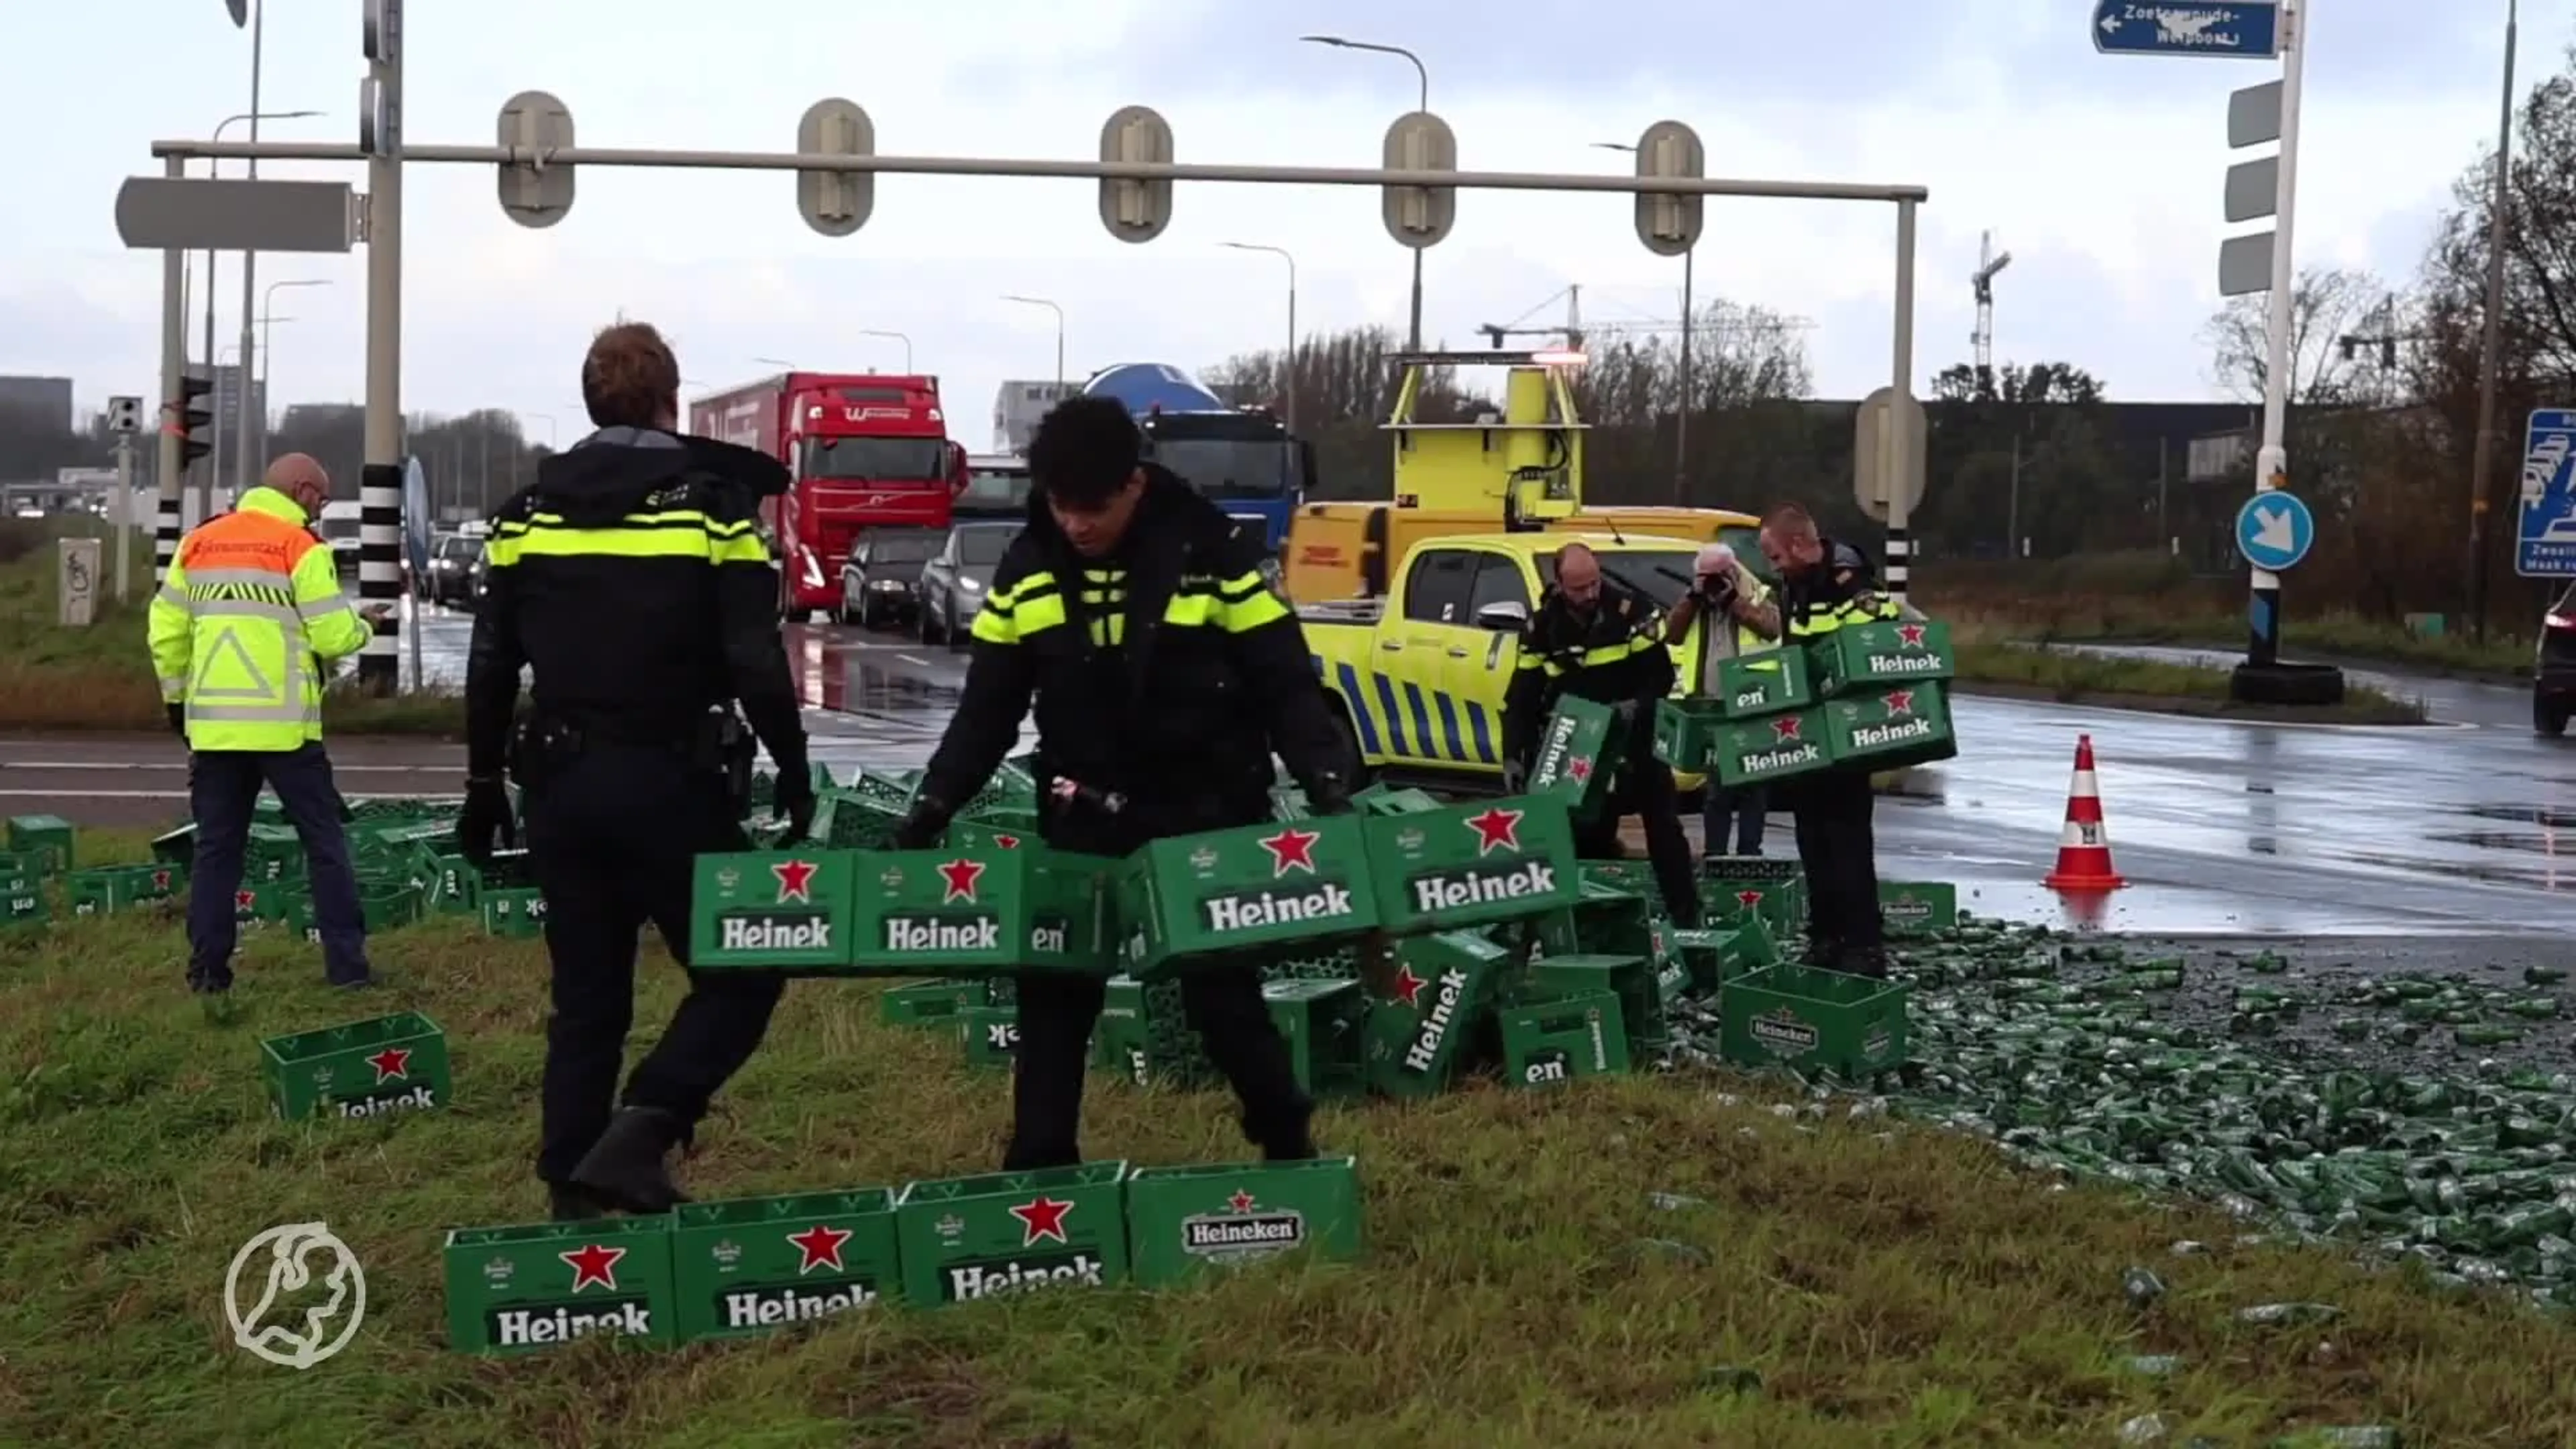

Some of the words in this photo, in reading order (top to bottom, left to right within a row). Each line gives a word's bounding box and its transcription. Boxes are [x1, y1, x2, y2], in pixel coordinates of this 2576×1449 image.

[1869, 653, 1943, 673] Heinek
[1852, 717, 1931, 747] Heinek
[1538, 716, 1576, 788] Heinek
[1743, 743, 1819, 773] Heinek
[1414, 861, 1556, 912] Heinek
[1205, 883, 1352, 931] Heinek
[721, 916, 831, 949] Heinek
[886, 916, 999, 951] Heinek
[1406, 966, 1467, 1071] Heinek
[1525, 1058, 1565, 1083] en
[1192, 1220, 1294, 1244] Heineken
